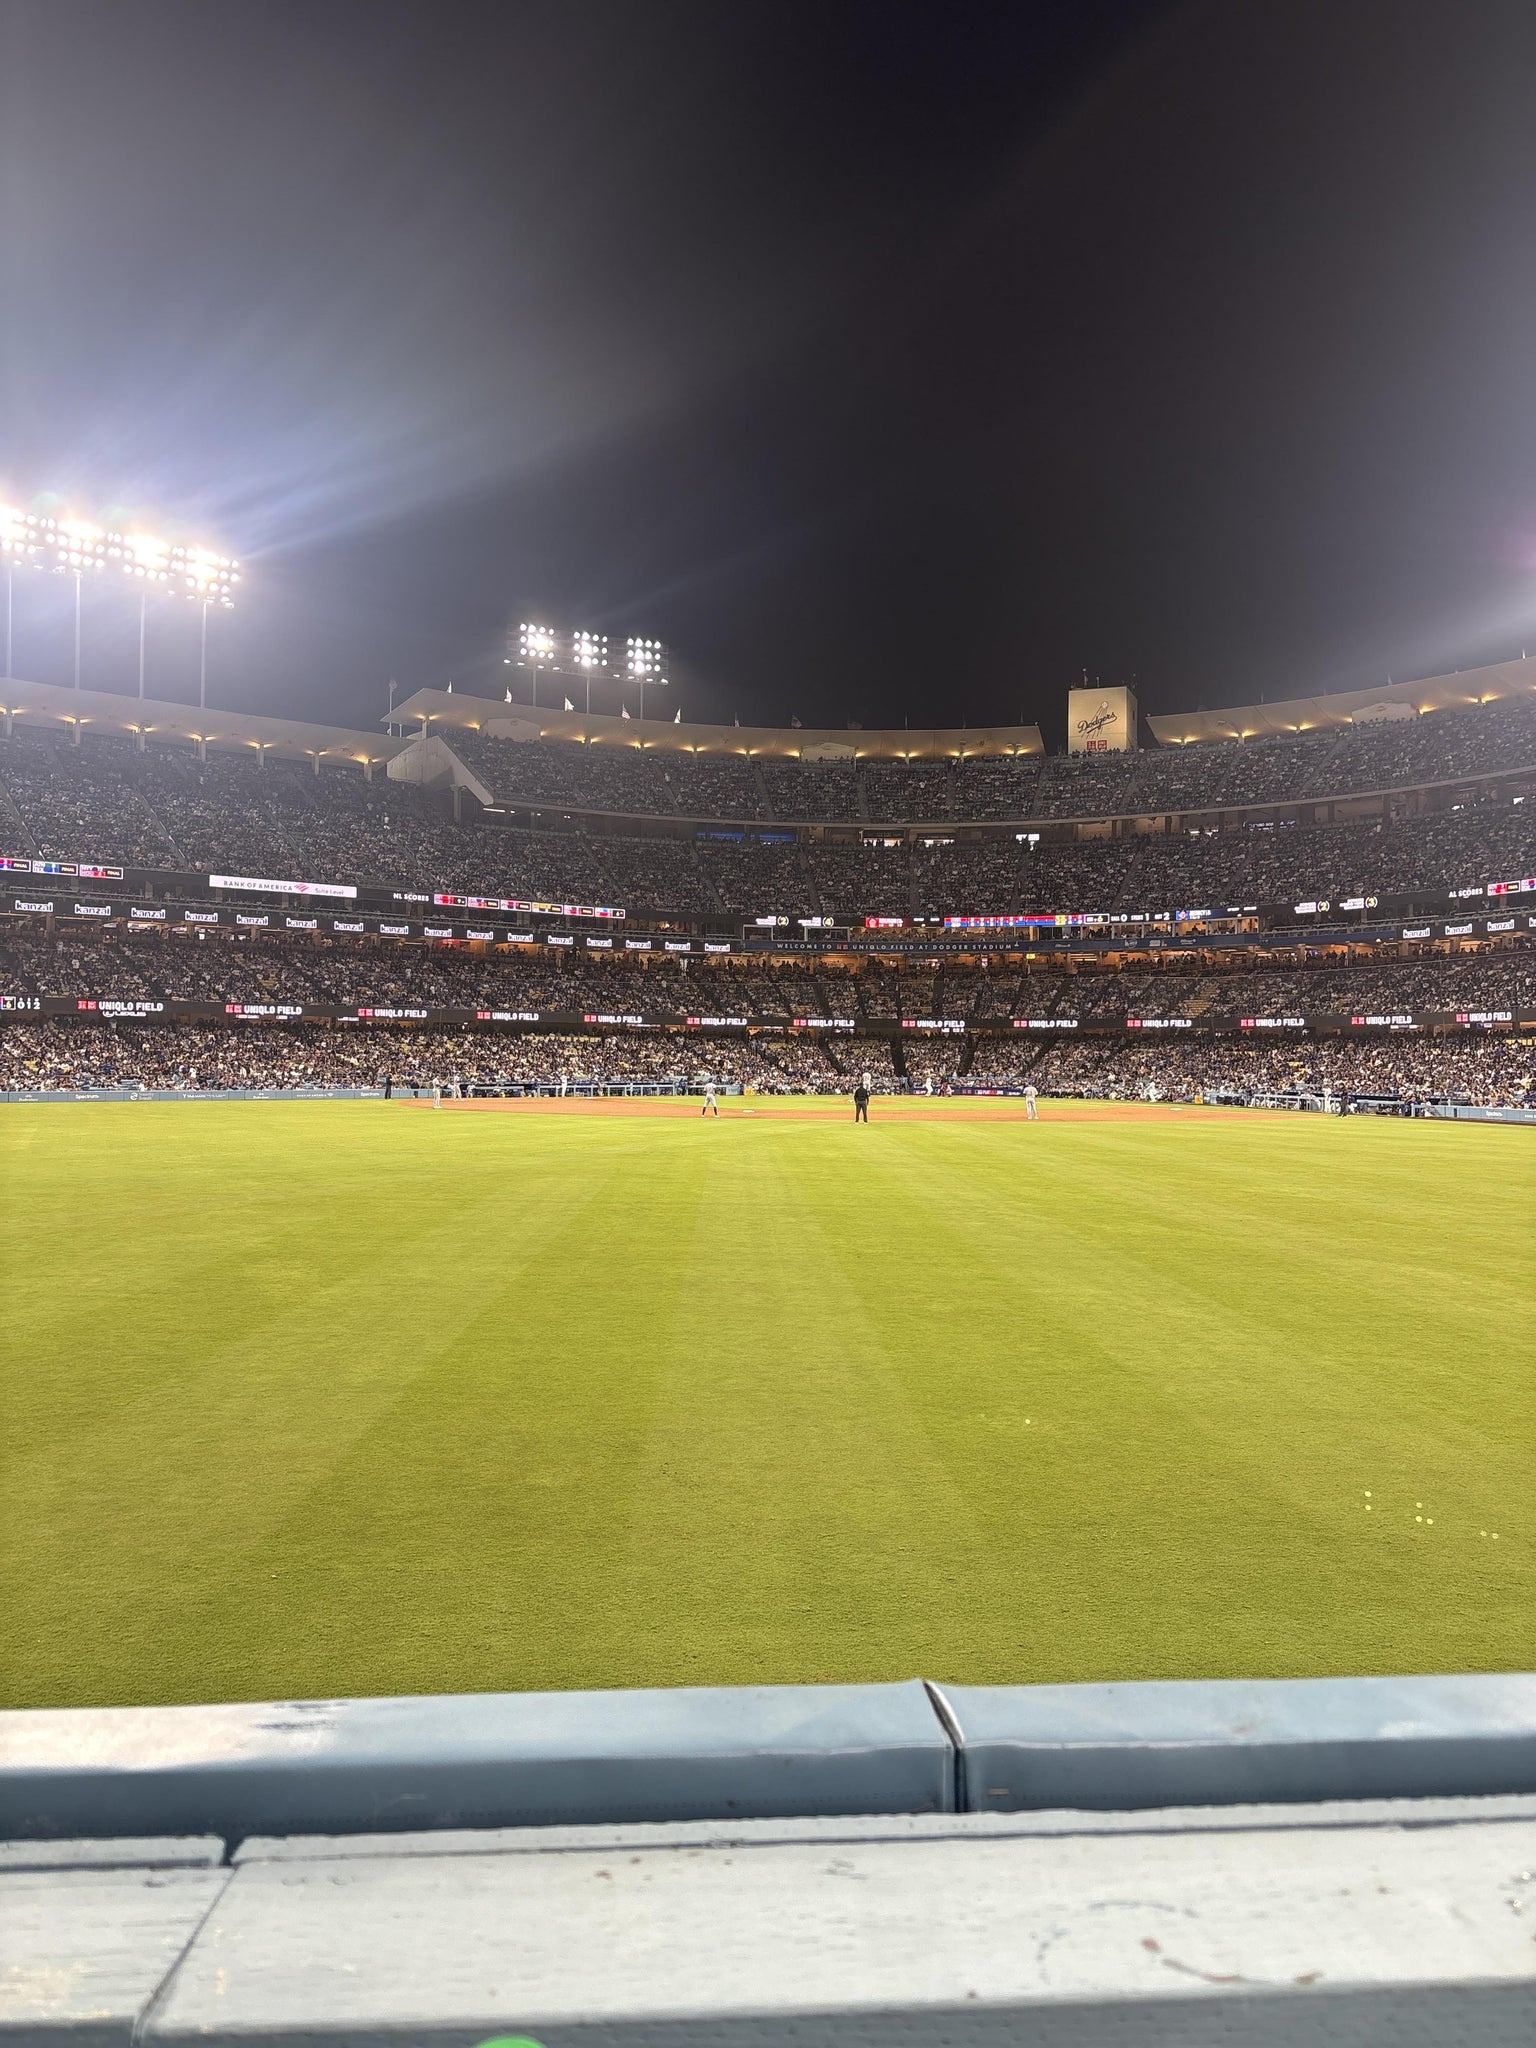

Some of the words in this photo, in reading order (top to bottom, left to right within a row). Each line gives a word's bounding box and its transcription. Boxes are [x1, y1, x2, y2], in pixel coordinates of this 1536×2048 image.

[1078, 712, 1117, 734] Dodgers
[1121, 914, 1127, 922] 0
[1145, 913, 1149, 921] 1
[1163, 912, 1170, 920] 2
[99, 1001, 133, 1011] UNIQLO
[136, 1002, 163, 1011] FIELD
[244, 1005, 275, 1015] UNIQLO
[277, 1006, 302, 1015] FIELD
[375, 1009, 403, 1018] UNIQLO
[405, 1010, 427, 1018] FIELD
[492, 1012, 517, 1021] UNIQLO
[519, 1012, 539, 1021] FIELD
[1470, 1013, 1492, 1022] UNIQLO
[1493, 1012, 1512, 1021] FIELD
[598, 1015, 621, 1023] UNIQLO
[623, 1016, 642, 1024] FIELD
[701, 1018, 726, 1026] UNIQLO
[727, 1018, 747, 1026] FIELD
[808, 1019, 833, 1027] UNIQLO
[917, 1020, 942, 1028] UNIQLO
[944, 1020, 965, 1028] FIELD
[1029, 1020, 1055, 1028] UNIQLO
[1056, 1020, 1077, 1028] FIELD
[1142, 1020, 1168, 1028] UNIQLO
[1170, 1020, 1191, 1028] FIELD
[1256, 1019, 1282, 1027] UNIQLO
[1283, 1018, 1304, 1026] FIELD
[1366, 1016, 1390, 1025] UNIQLO
[1392, 1016, 1412, 1024] FIELD
